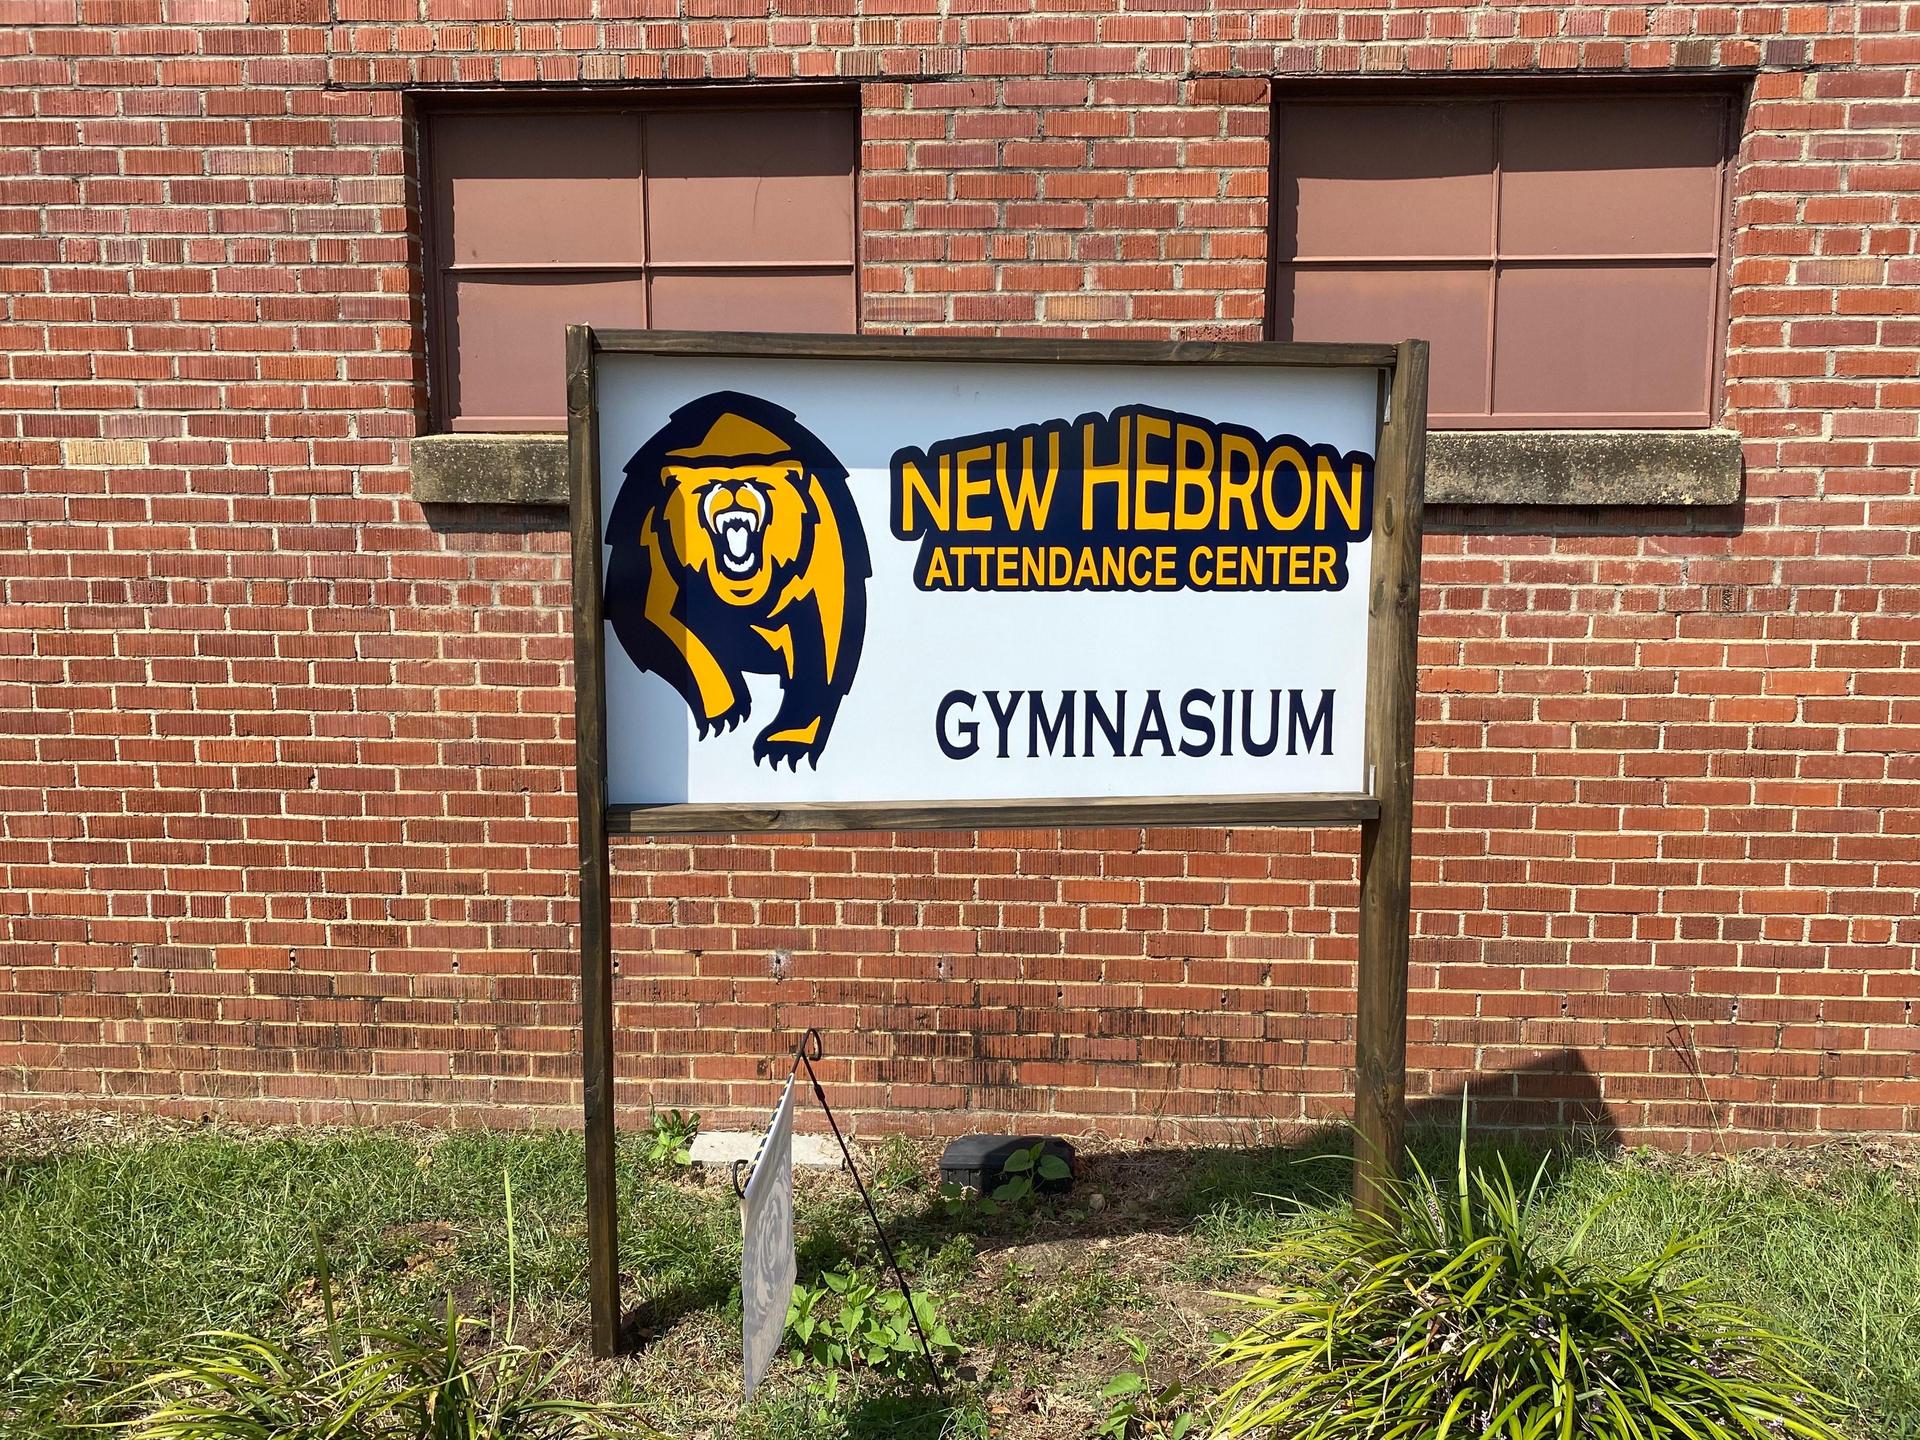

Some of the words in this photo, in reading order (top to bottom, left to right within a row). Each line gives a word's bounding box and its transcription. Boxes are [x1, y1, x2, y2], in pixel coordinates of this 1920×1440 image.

[902, 431, 1060, 532] NEW
[1081, 413, 1362, 531] HEBRON
[924, 545, 1177, 587] ATTENDANCE
[1188, 545, 1337, 586] CENTER
[935, 687, 1336, 760] GYMNASIUM
